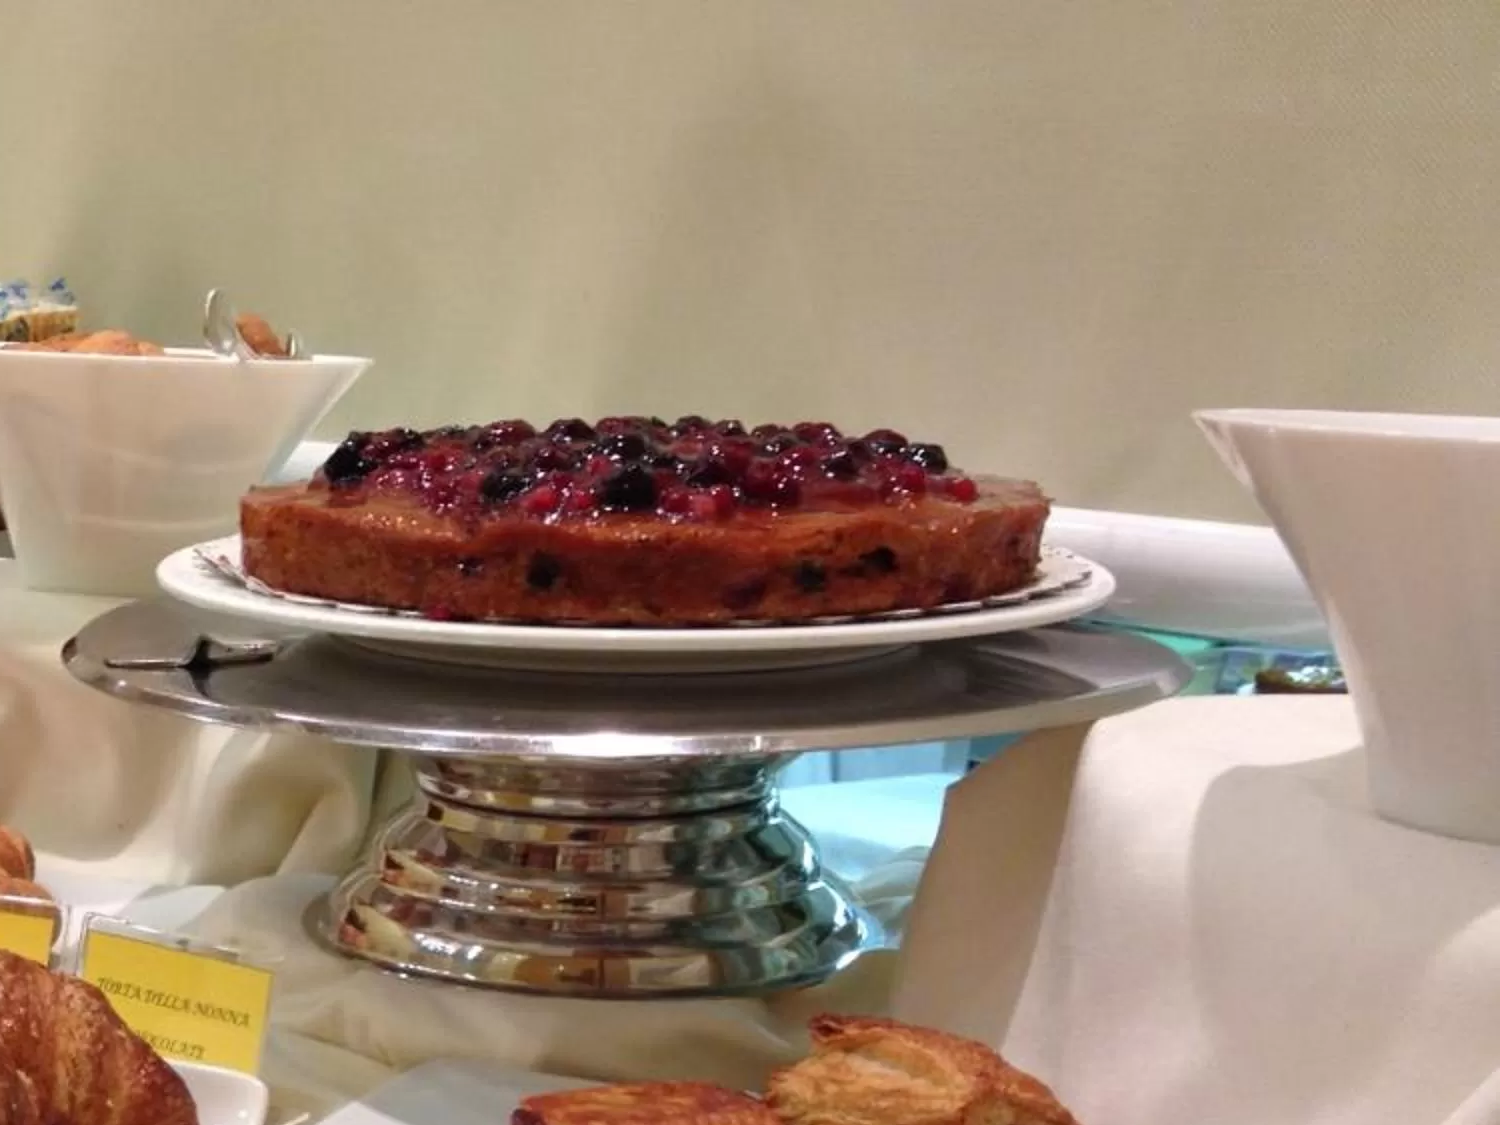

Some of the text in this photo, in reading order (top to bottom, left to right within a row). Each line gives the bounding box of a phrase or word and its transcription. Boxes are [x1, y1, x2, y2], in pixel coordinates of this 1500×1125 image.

[97, 976, 252, 1027] TORTA DELLA NONNA
